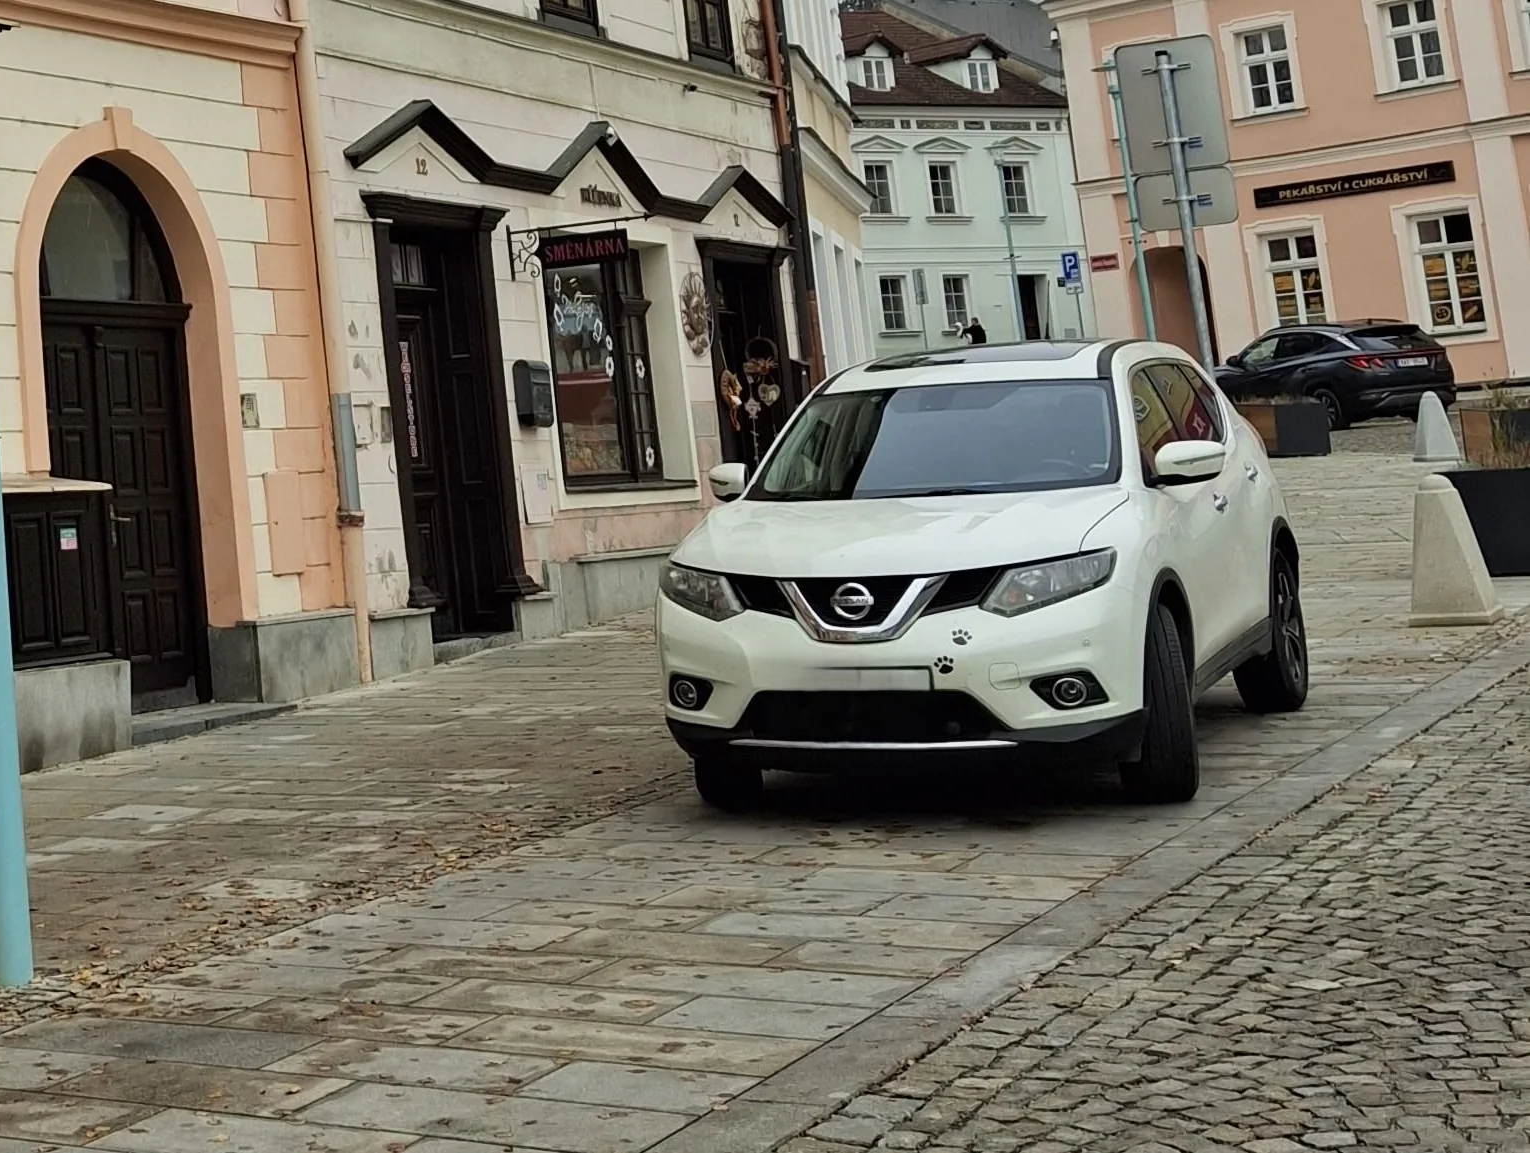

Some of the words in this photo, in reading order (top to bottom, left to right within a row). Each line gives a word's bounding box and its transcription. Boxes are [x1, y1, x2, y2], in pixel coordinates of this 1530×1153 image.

[415, 157, 429, 176] 12
[1278, 181, 1342, 200] PEKAŘSTVÍ
[1351, 167, 1428, 190] CUKRÁŘSTVÍ
[1064, 255, 1076, 273] P
